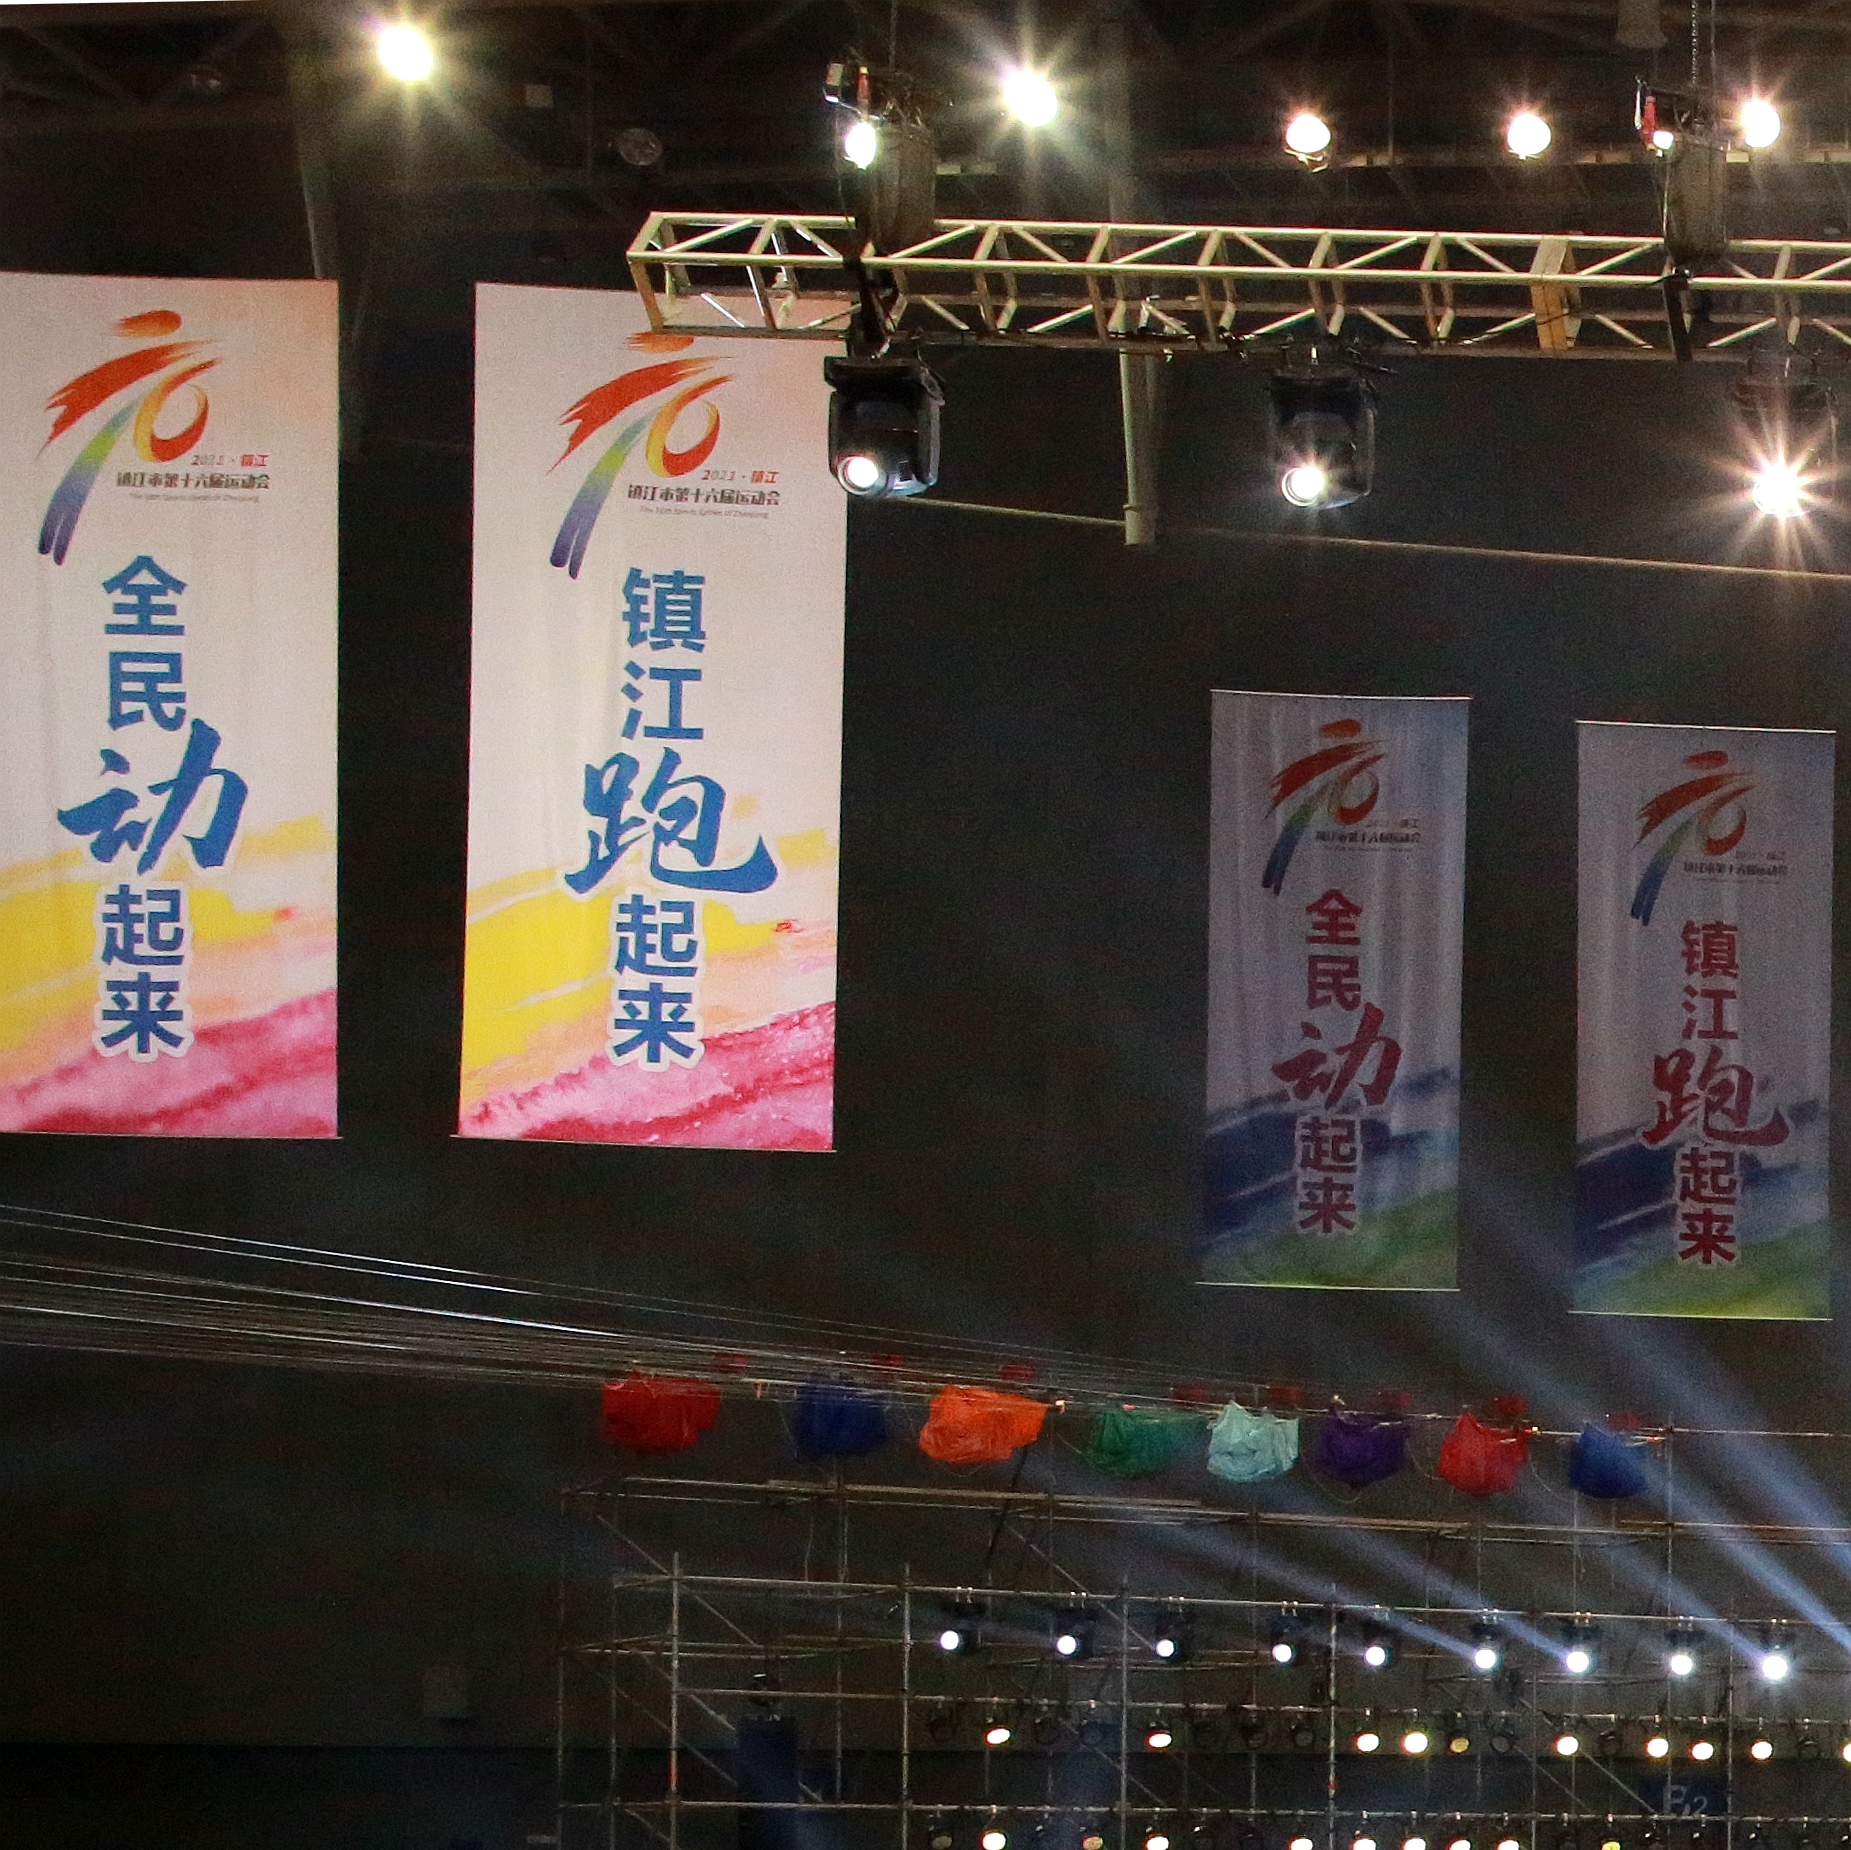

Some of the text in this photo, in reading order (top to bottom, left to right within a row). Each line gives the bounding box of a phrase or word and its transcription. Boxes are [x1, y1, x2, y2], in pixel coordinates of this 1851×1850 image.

[58, 555, 249, 1054] 全民动起来
[565, 567, 778, 1065] 镇江跑起来
[1274, 889, 1402, 1234] 全民动起来
[1641, 921, 1789, 1266] 镇江跑起来
